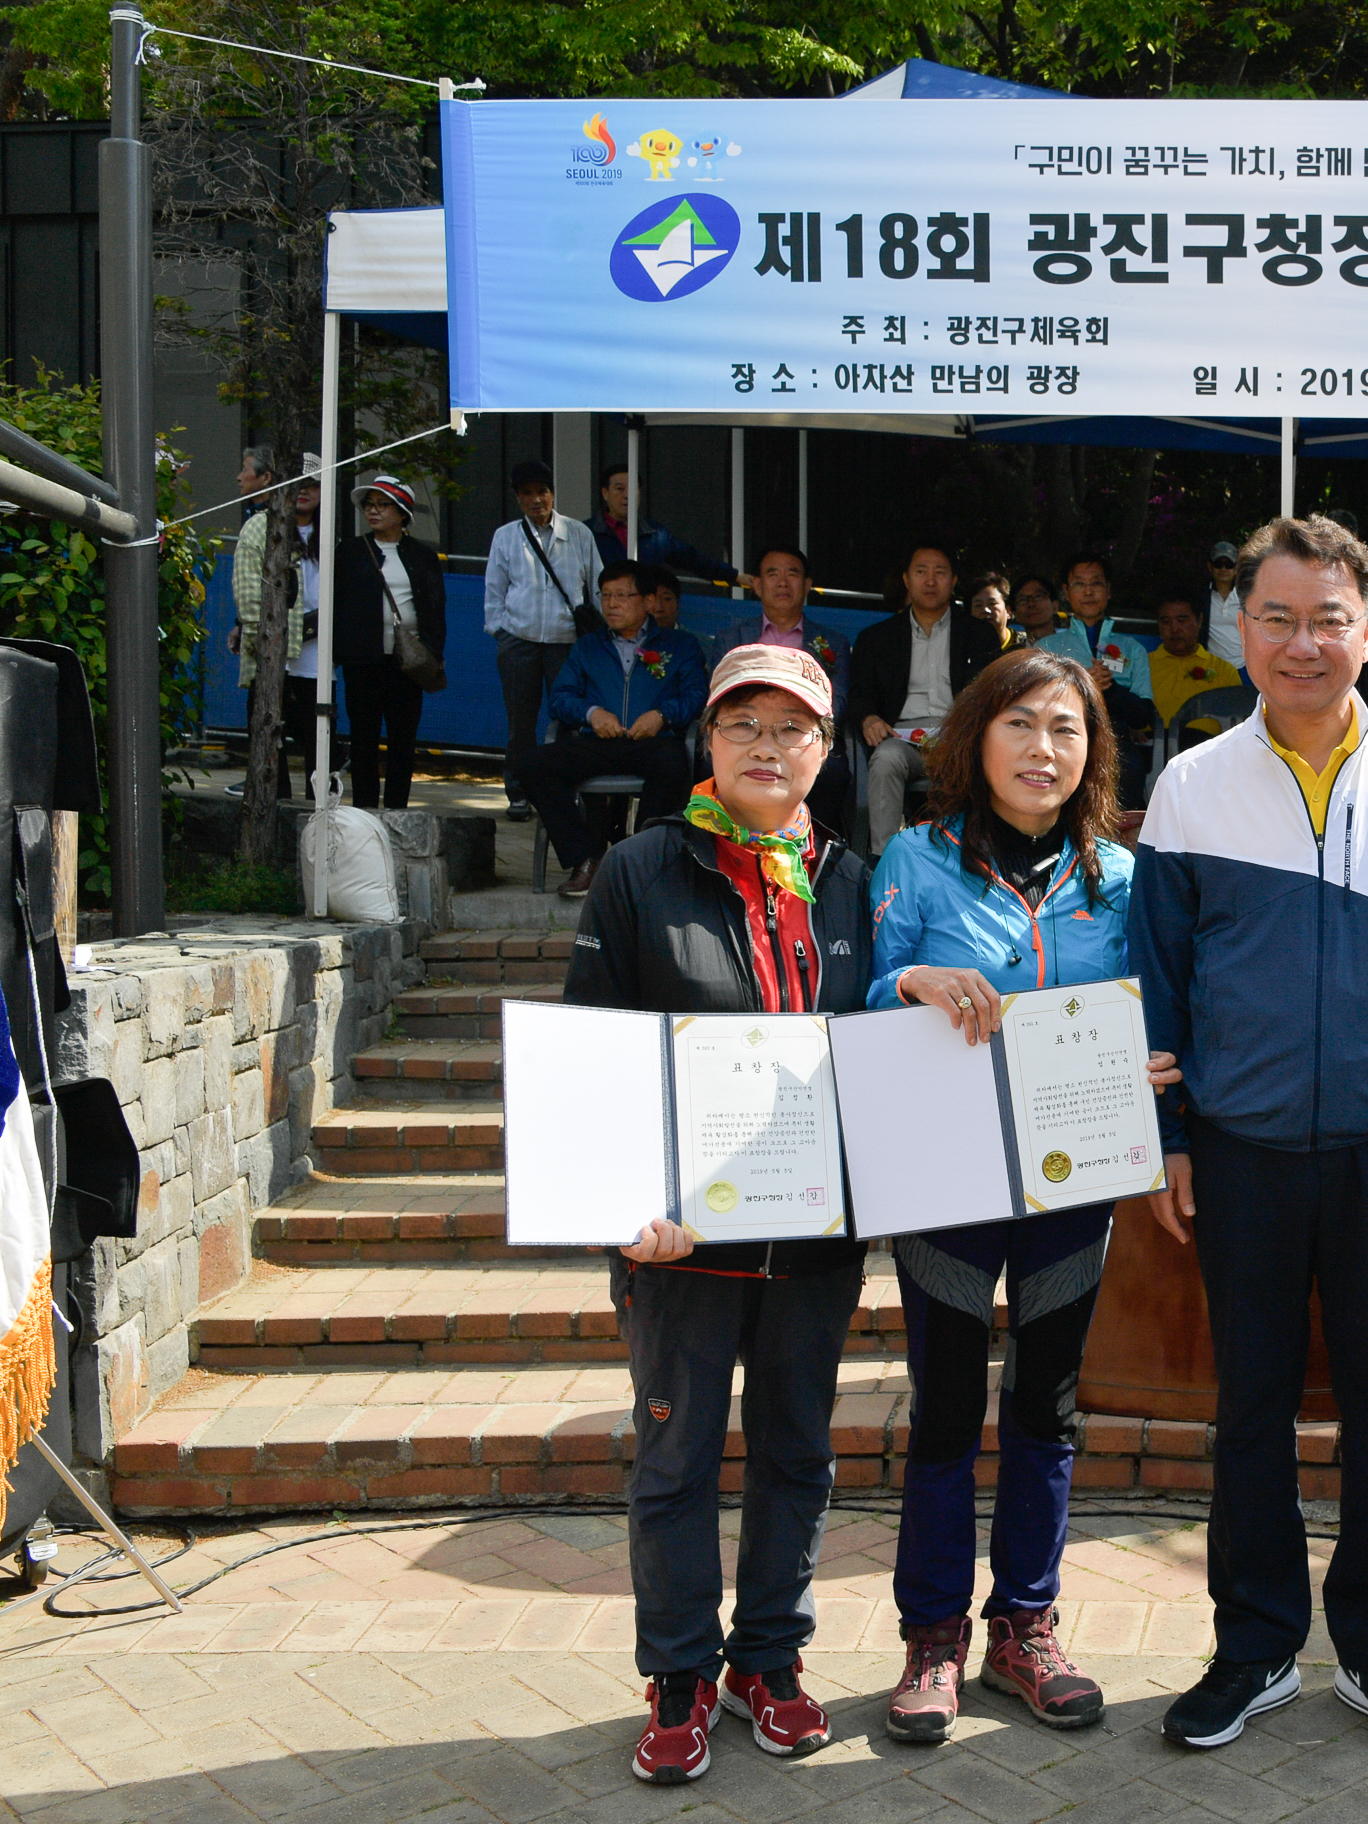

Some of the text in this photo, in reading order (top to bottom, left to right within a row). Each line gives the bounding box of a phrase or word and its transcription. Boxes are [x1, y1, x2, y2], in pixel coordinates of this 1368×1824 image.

[566, 168, 623, 179] SEOUL 2019
[1123, 146, 1209, 176] 꿈꾸는
[1219, 145, 1285, 181] 가치,
[1296, 146, 1352, 177] 함께
[753, 211, 991, 283] 제18회
[946, 315, 1109, 346] 광진구체육회
[834, 363, 915, 394] 아차산
[930, 364, 1010, 394] 만남의
[1026, 365, 1080, 395] 광장
